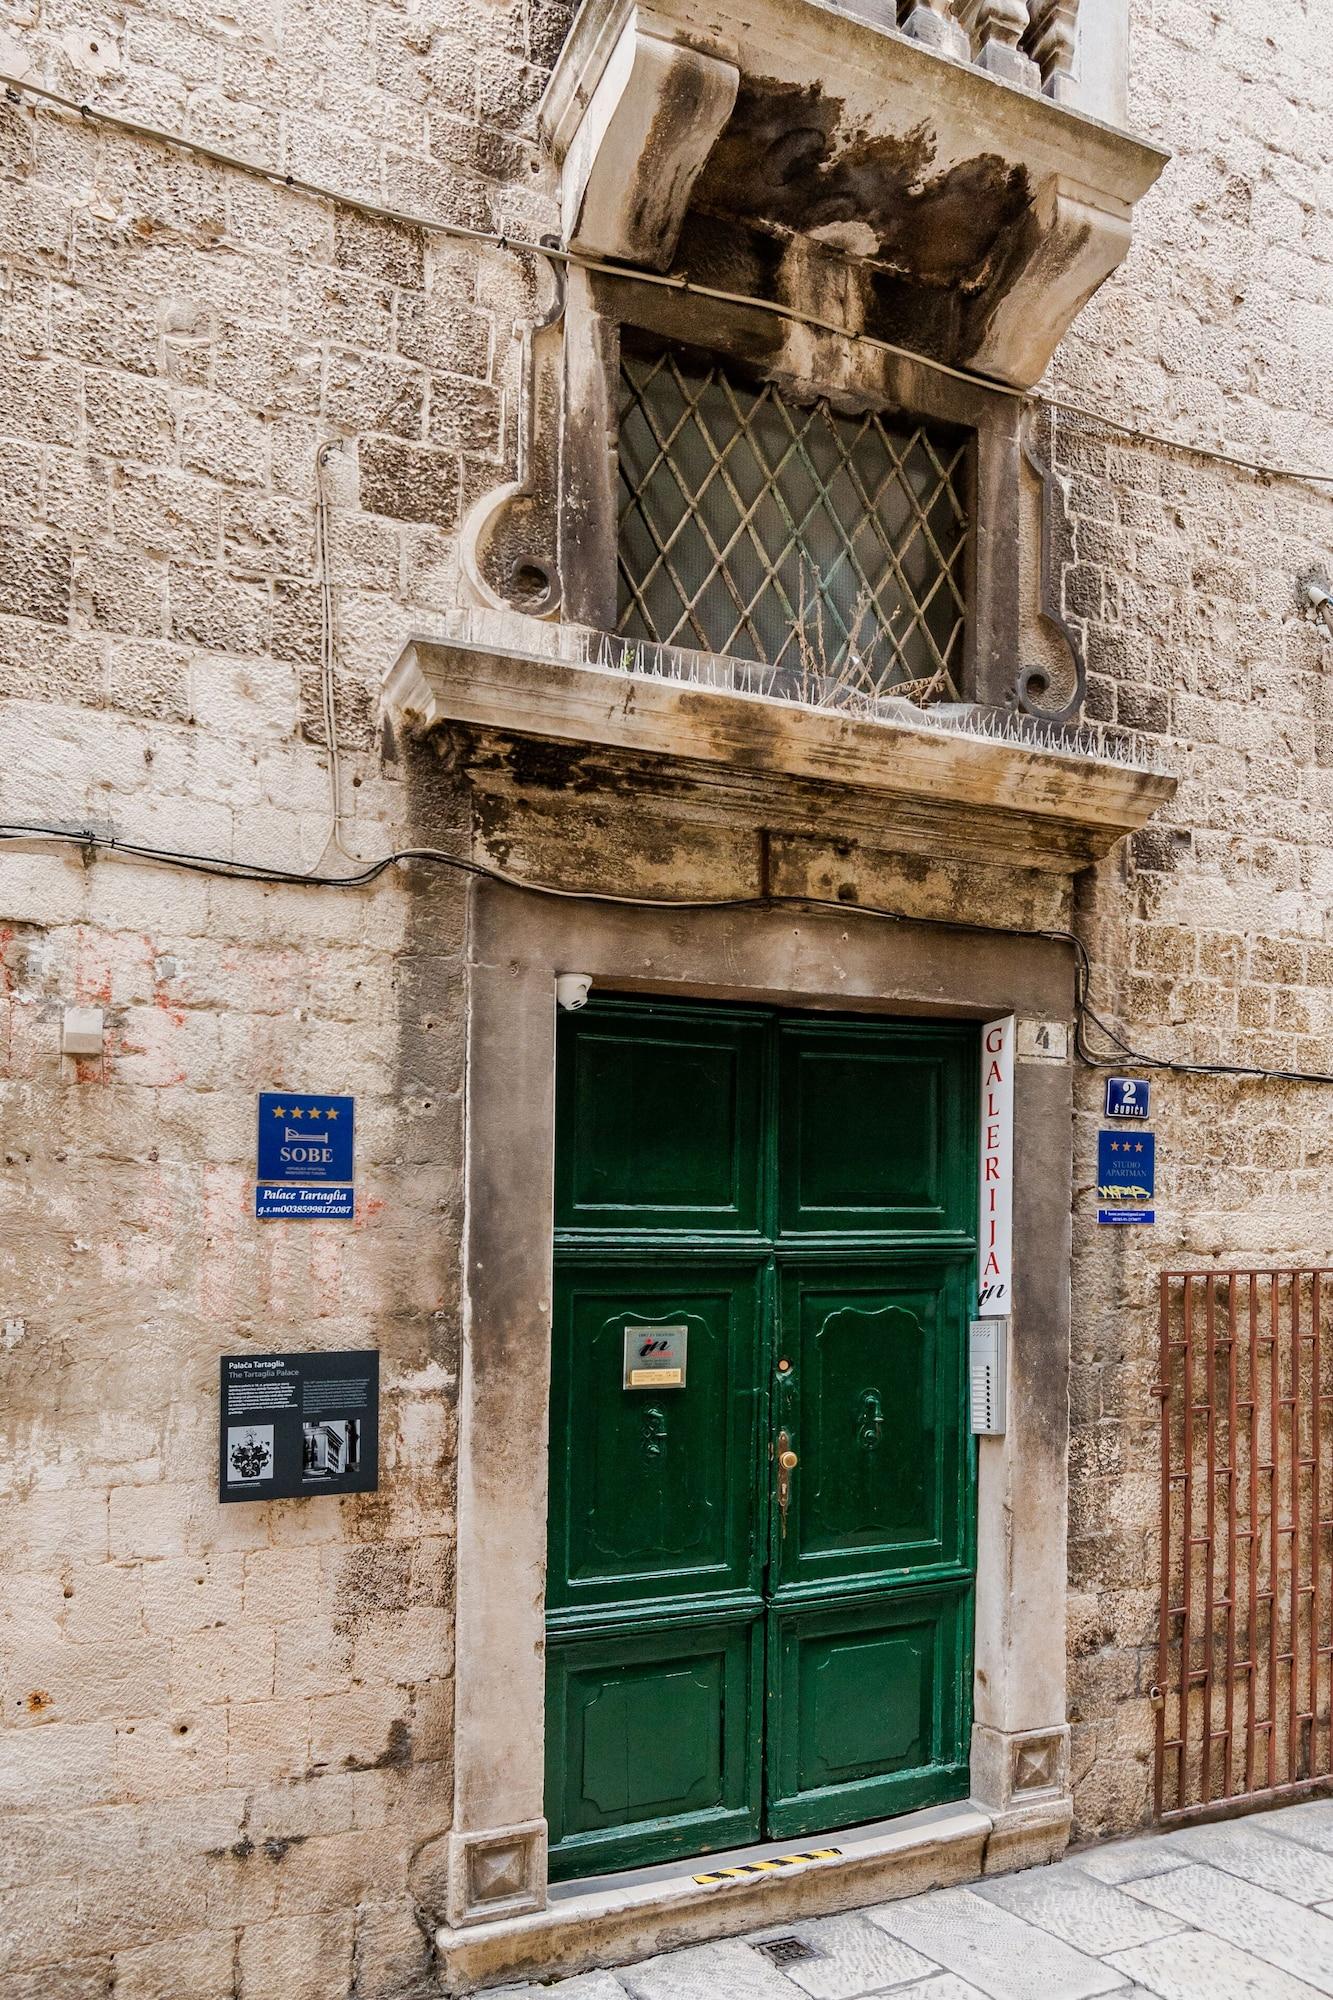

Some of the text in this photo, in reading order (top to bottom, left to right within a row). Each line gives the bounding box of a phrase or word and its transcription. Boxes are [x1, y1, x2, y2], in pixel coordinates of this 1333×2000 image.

[1035, 1026, 1049, 1049] 4
[1122, 1081, 1137, 1104] 2
[280, 1147, 334, 1163] SOBE
[984, 1027, 1004, 1275] GALERIJA
[1112, 1160, 1141, 1169] STUDIO
[1105, 1169, 1148, 1177] APARTMAN
[263, 1188, 347, 1205] Palace Tartaglia
[253, 1360, 285, 1369] Tartaglia
[228, 1369, 300, 1379] The Tartaglia Palace
